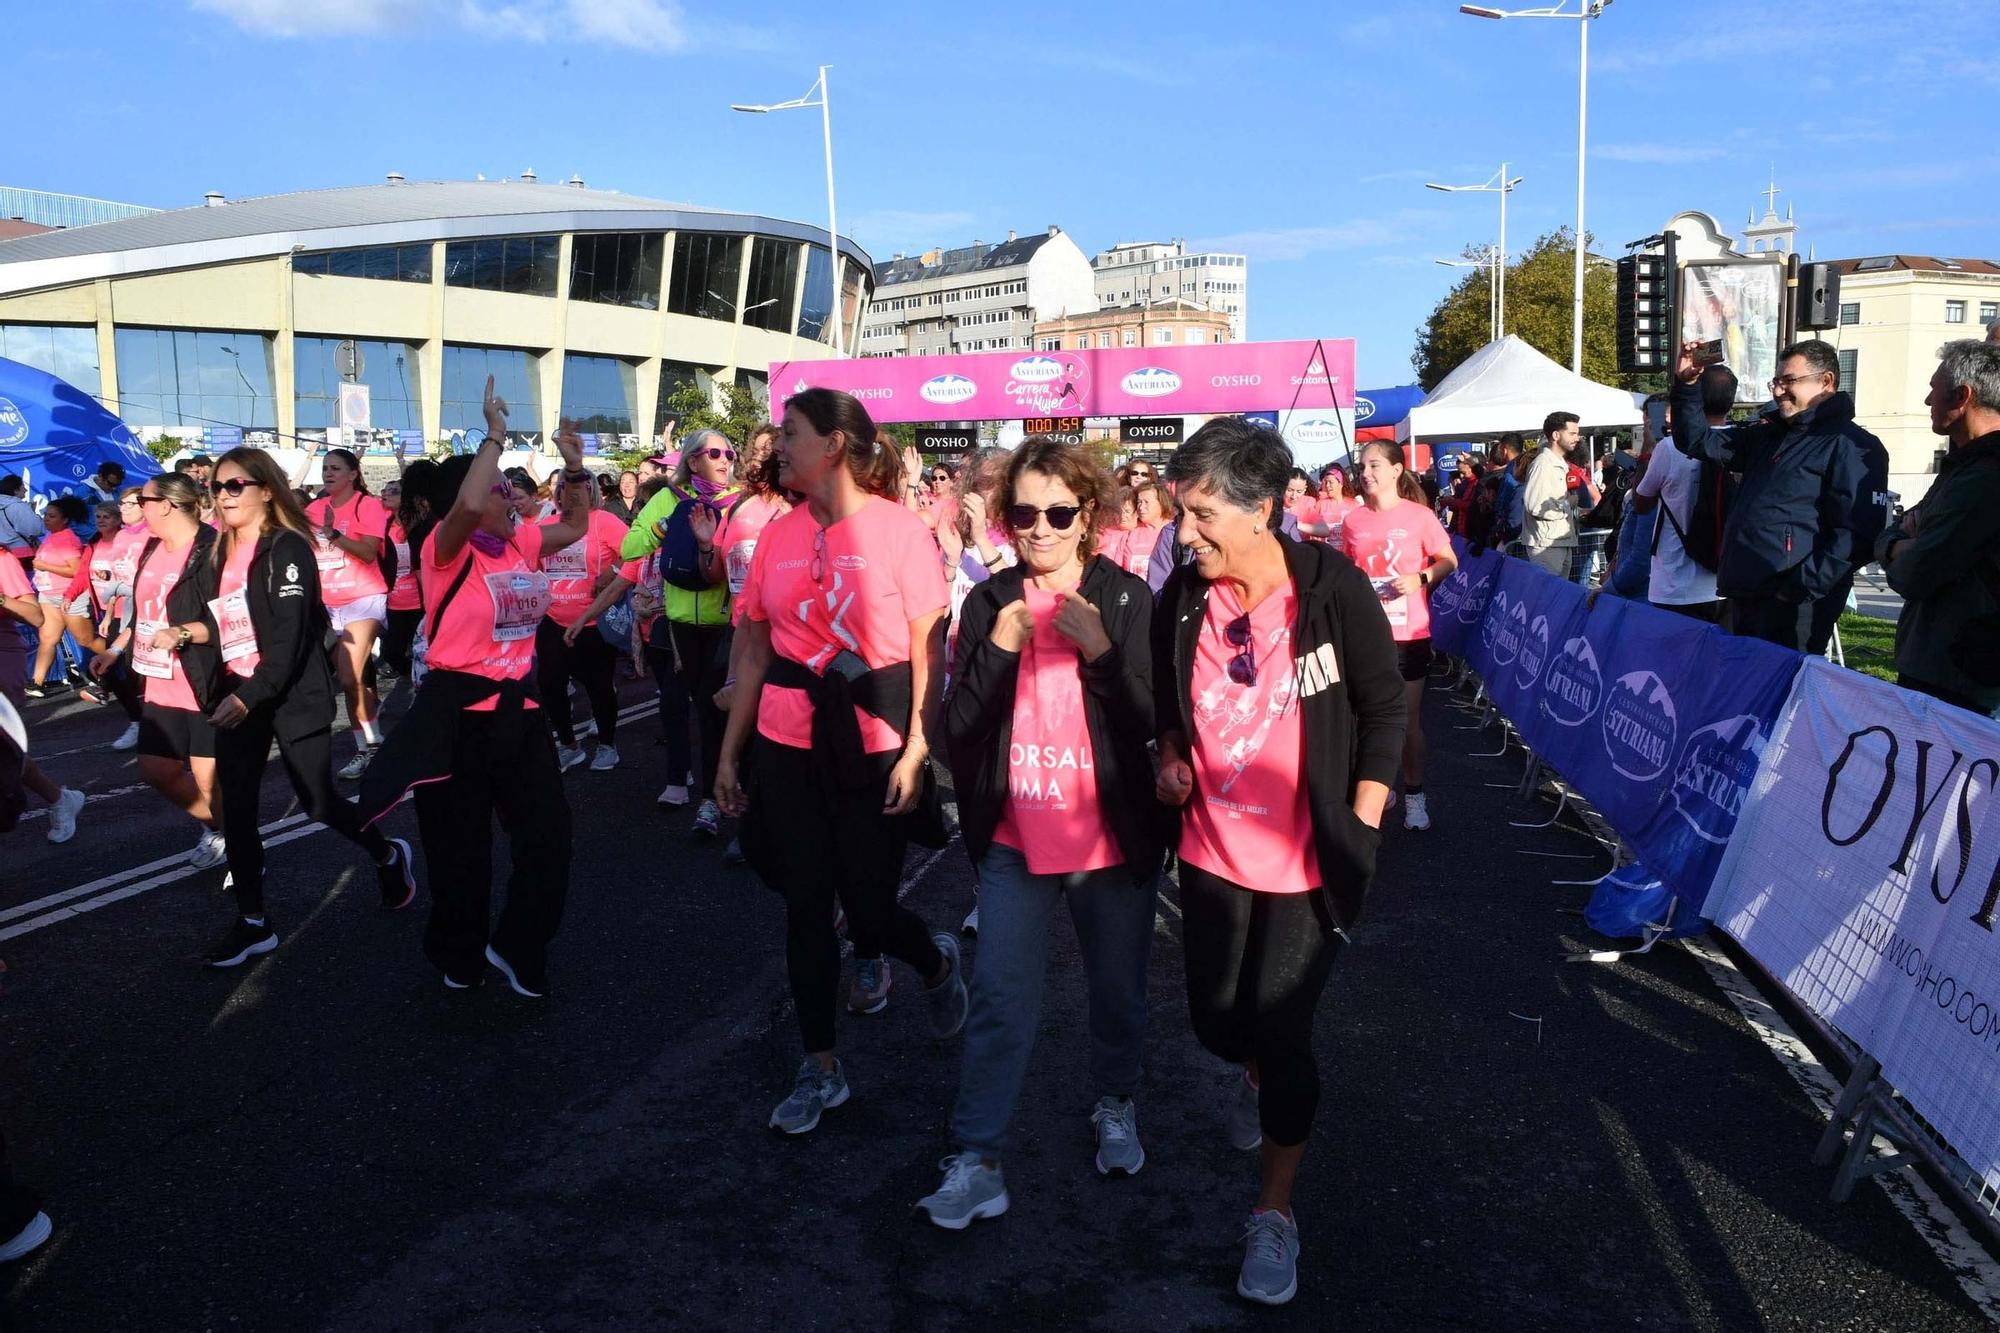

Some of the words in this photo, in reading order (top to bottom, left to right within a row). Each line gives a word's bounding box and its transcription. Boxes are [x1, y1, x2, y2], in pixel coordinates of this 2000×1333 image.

[1126, 379, 1177, 390] ASTURIANA
[1211, 374, 1261, 387] OYSHO
[1291, 375, 1340, 385] Santander
[850, 388, 893, 400] OYSHO
[924, 385, 973, 398] ASTURIANA
[1005, 381, 1050, 395] Carrera
[1031, 394, 1067, 415] Mujer
[1129, 425, 1175, 437] OYSHO
[924, 436, 969, 449] OYSHO
[556, 555, 574, 563] 016
[518, 597, 538, 610] 016
[228, 617, 248, 631] 016
[1605, 704, 1667, 768] STURIANA
[1010, 742, 1092, 770] ORSAL
[1008, 771, 1064, 801] UMA
